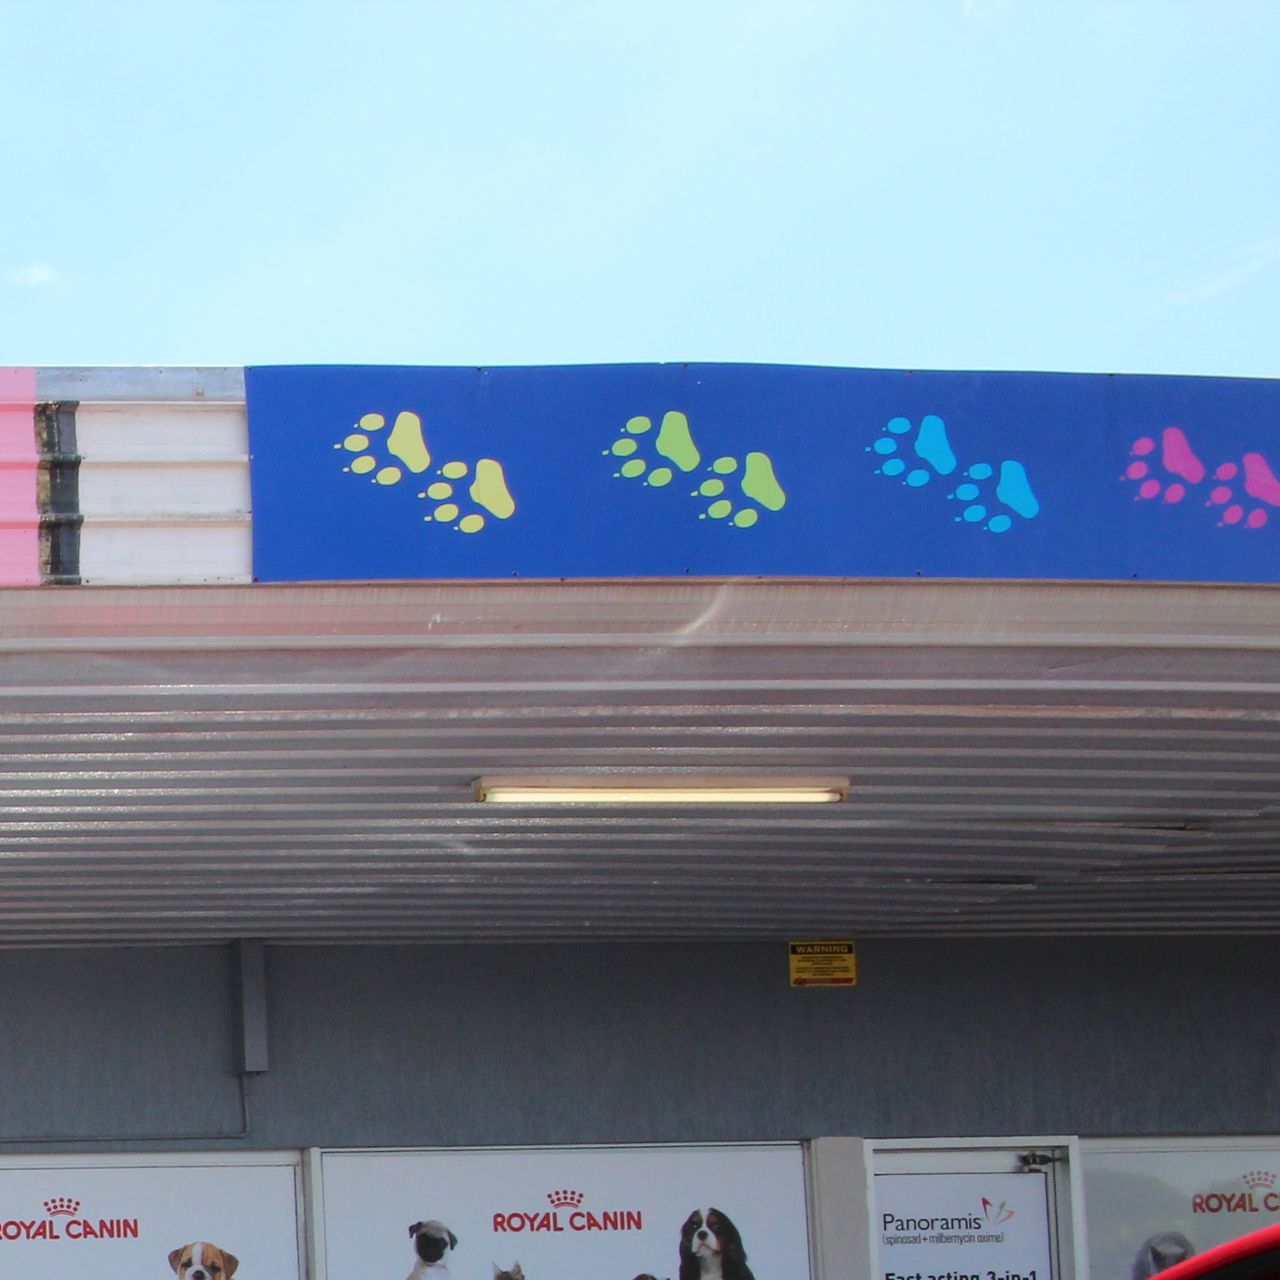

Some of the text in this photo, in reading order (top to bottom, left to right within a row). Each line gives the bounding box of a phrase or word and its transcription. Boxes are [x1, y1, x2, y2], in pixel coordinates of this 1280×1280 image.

[796, 945, 849, 953] WARNING
[1192, 1193, 1259, 1213] ROYAL
[65, 1219, 138, 1239] CANIN
[493, 1211, 642, 1232] ROYAL CANIN
[883, 1213, 982, 1231] Panoramis
